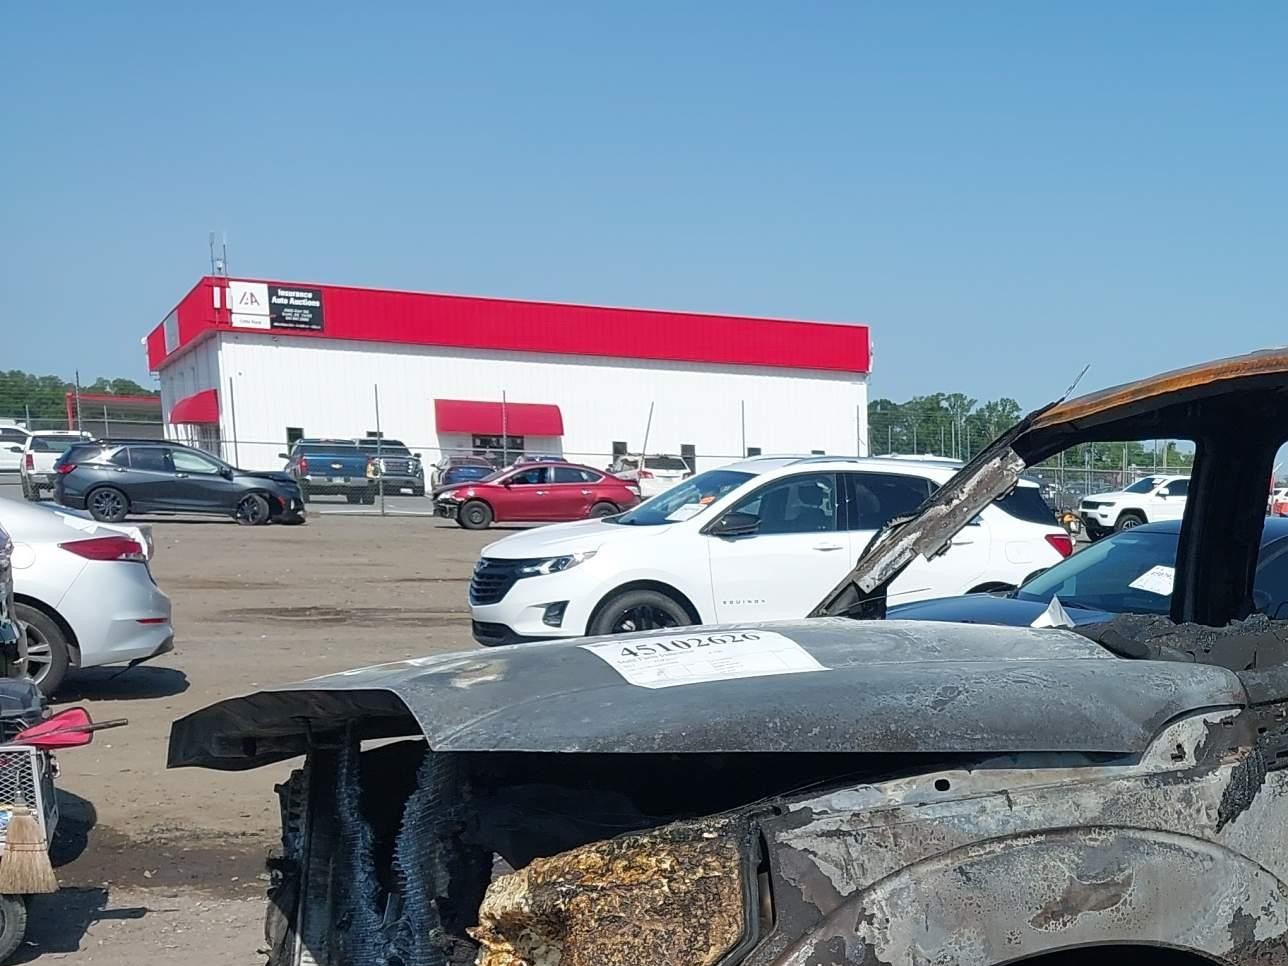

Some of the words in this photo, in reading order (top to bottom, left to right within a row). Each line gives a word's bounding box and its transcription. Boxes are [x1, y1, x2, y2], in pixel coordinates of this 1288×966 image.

[278, 288, 312, 298] Insurance
[271, 296, 288, 304] Auto
[289, 297, 320, 306] Auctions
[621, 633, 761, 657] 45102626
